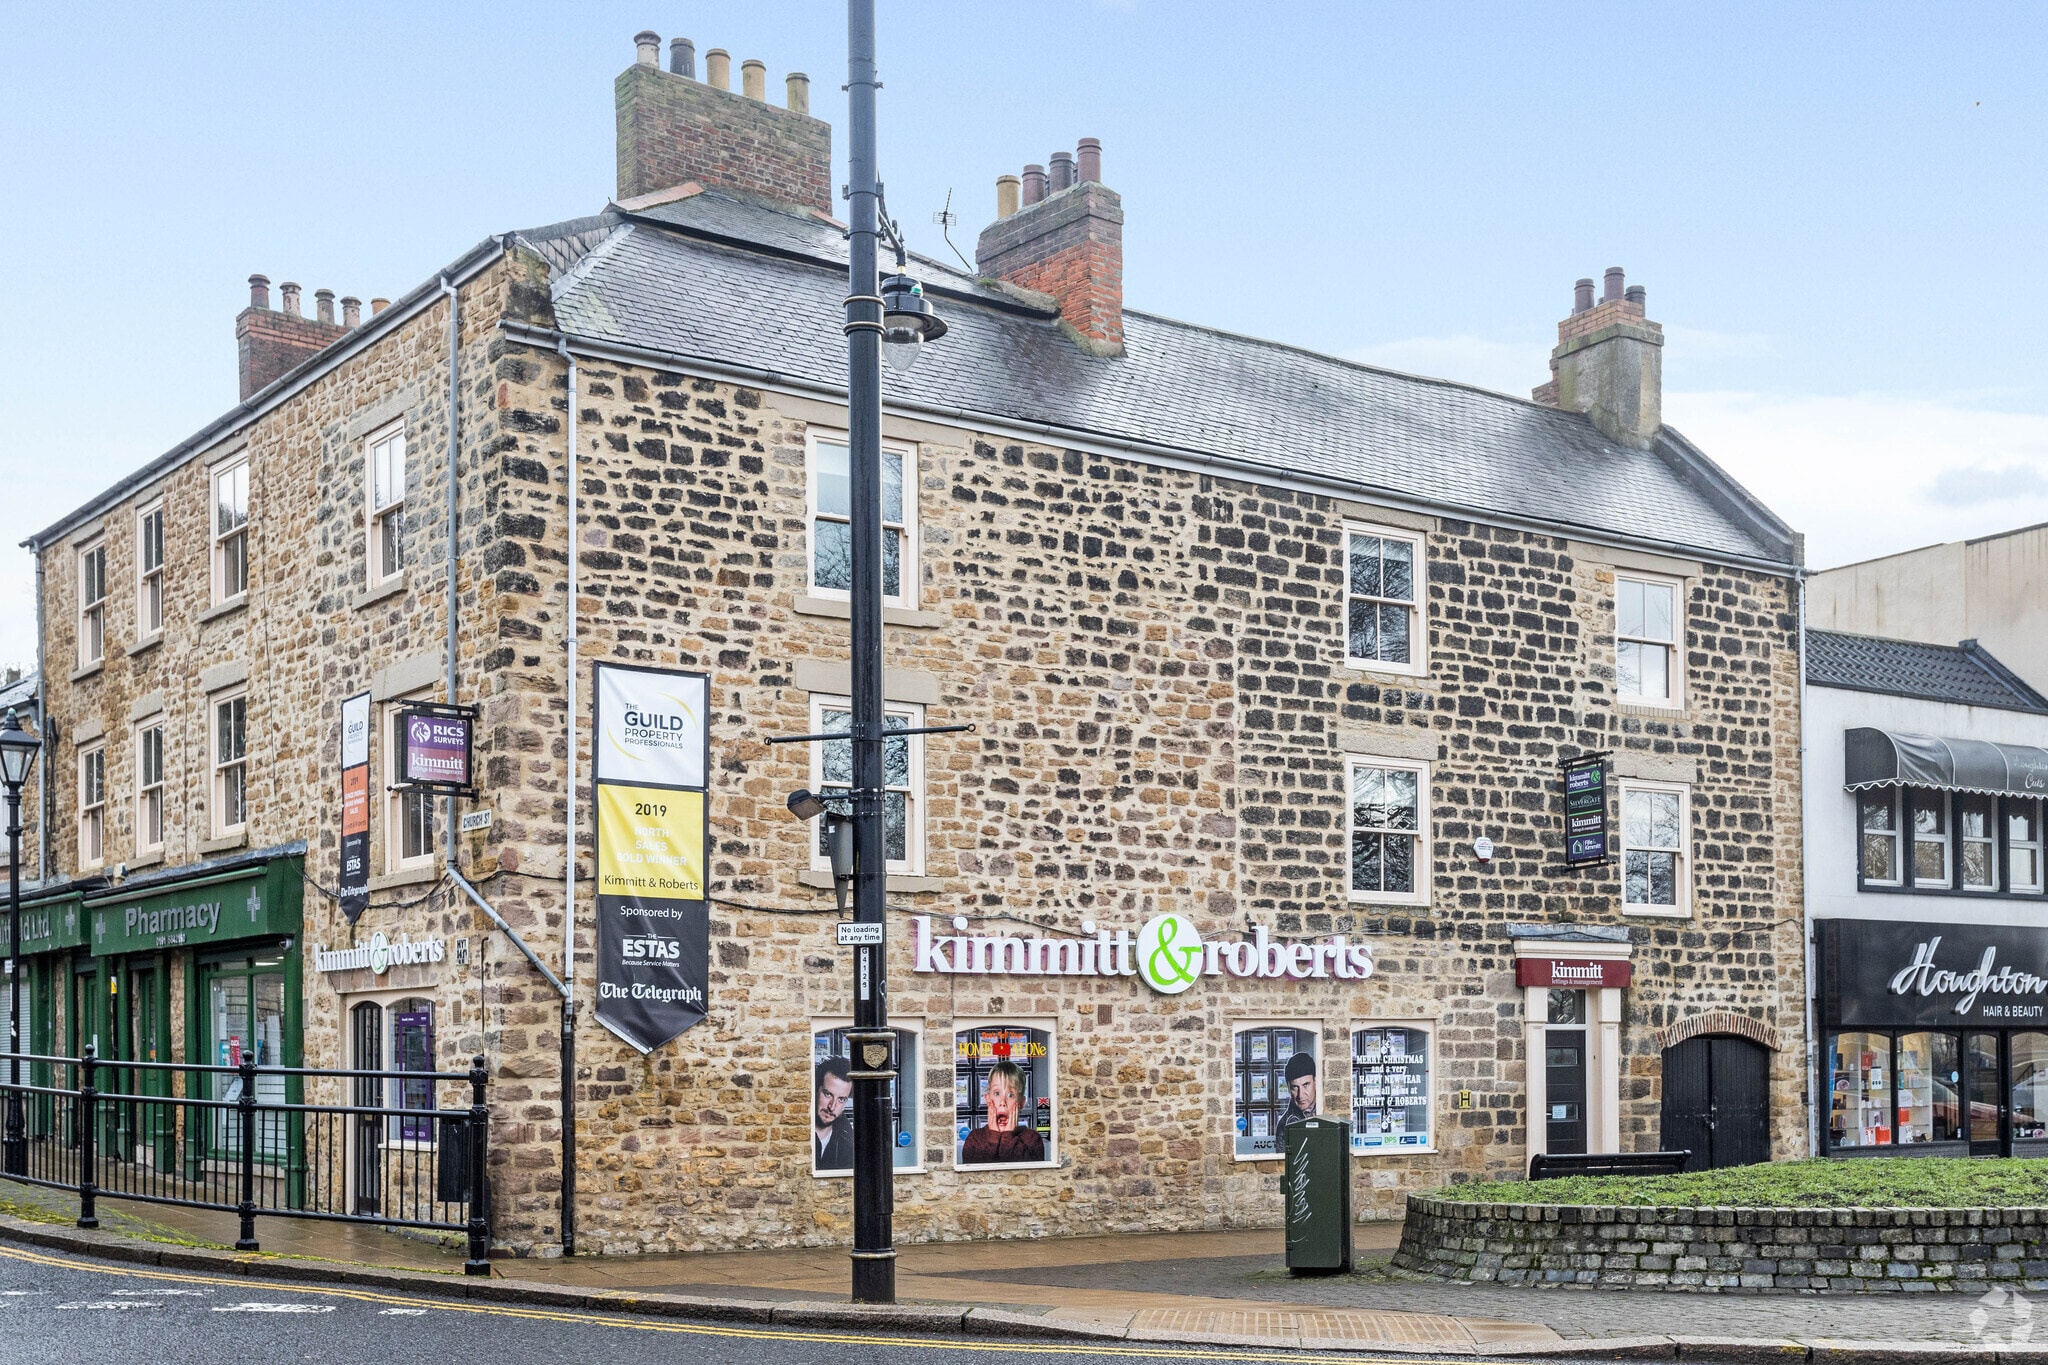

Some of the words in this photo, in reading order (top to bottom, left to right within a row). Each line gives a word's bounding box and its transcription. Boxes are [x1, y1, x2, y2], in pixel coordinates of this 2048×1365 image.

[348, 721, 363, 734] GUILD
[624, 711, 683, 731] GUILD
[433, 725, 464, 737] RICS
[624, 728, 683, 741] PROPERTY
[433, 736, 464, 745] SURVEYS
[624, 737, 683, 749] PROFESSIONALS
[411, 752, 464, 770] kimmitt
[1569, 772, 1590, 782] kimmitt
[2025, 773, 2045, 789] Cuts
[1569, 780, 1589, 789] roberts
[635, 803, 667, 817] 2019
[463, 814, 483, 829] CHURCH
[1571, 815, 1601, 828] kimmitt
[634, 825, 669, 838] NORTH
[635, 840, 668, 852] SALES
[346, 858, 361, 872] ESTAS
[616, 852, 643, 863] GOLD
[645, 853, 687, 867] WINNER
[604, 875, 646, 888] Kimmitt
[648, 877, 657, 888] &
[659, 878, 699, 890] Roberts
[125, 901, 221, 937] Pharmacy
[620, 905, 669, 918] Sponsored
[671, 908, 683, 920] by
[853, 925, 879, 933] loading
[313, 939, 371, 972] kimmitt
[372, 932, 387, 971] &
[386, 932, 445, 966] roberts
[622, 939, 680, 959] ESTAS
[912, 916, 1137, 976] kimmitt
[1149, 917, 1202, 986] &
[1201, 926, 1374, 981] roberts
[1551, 961, 1603, 979] kimmitt
[1889, 936, 2048, 1015] Houghton
[1551, 978, 1568, 986] lettings
[600, 982, 629, 999] The
[631, 982, 703, 1003] Telegraph
[1983, 1005, 2003, 1017] HAIR
[2004, 1005, 2011, 1017] &
[2012, 1005, 2044, 1017] BEAUTY
[959, 1042, 993, 1057] HOME
[1356, 1055, 1381, 1064] MERRY
[1382, 1054, 1424, 1064] CHRISTMAS
[1371, 1064, 1384, 1073] and
[1391, 1065, 1408, 1075] very
[1359, 1075, 1382, 1084] HAPPY
[1384, 1075, 1401, 1084] NEW
[1403, 1074, 1422, 1084] YEAR
[1363, 1086, 1381, 1096] from
[1381, 1085, 1391, 1095] all
[1410, 1086, 1418, 1095] at
[1353, 1097, 1385, 1107] KIMMITT
[1386, 1096, 1394, 1106] &
[1394, 1096, 1427, 1106] ROBERTS
[1460, 1091, 1471, 1107] H
[1384, 1136, 1397, 1144] DPS
